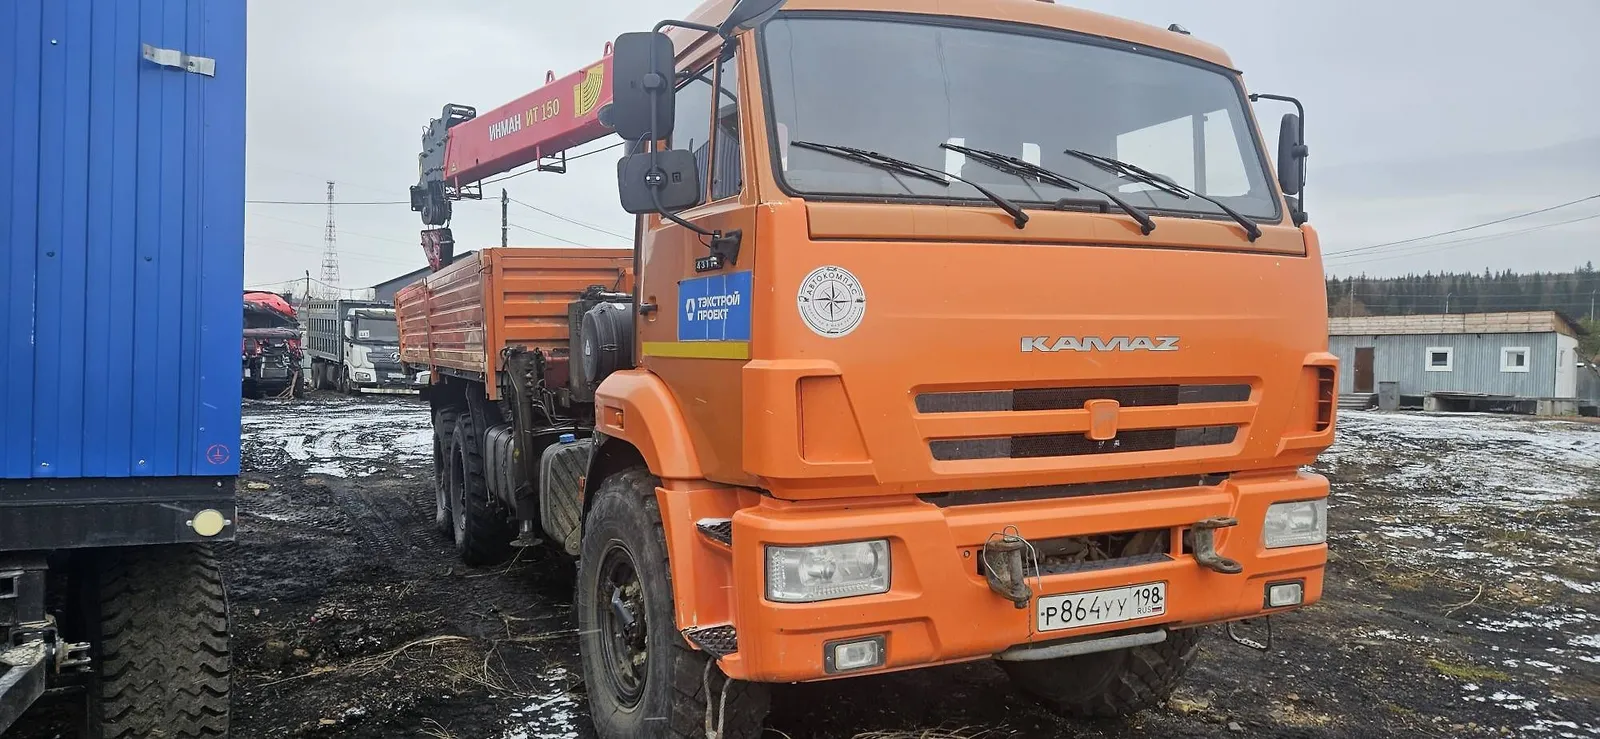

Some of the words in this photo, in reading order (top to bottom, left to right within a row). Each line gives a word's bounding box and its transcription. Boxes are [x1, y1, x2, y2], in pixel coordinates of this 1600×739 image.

[488, 113, 522, 142] ИНМАН
[525, 105, 539, 127] ИТ
[541, 98, 560, 121] 150
[806, 272, 858, 296] АВТОКОМПАС
[697, 290, 741, 308] ТЭКСТРОЙ
[697, 308, 729, 321] ПРОЕКТ
[1021, 336, 1180, 352] KAMAZ
[1133, 586, 1160, 606] 198
[1136, 604, 1152, 615] RUS
